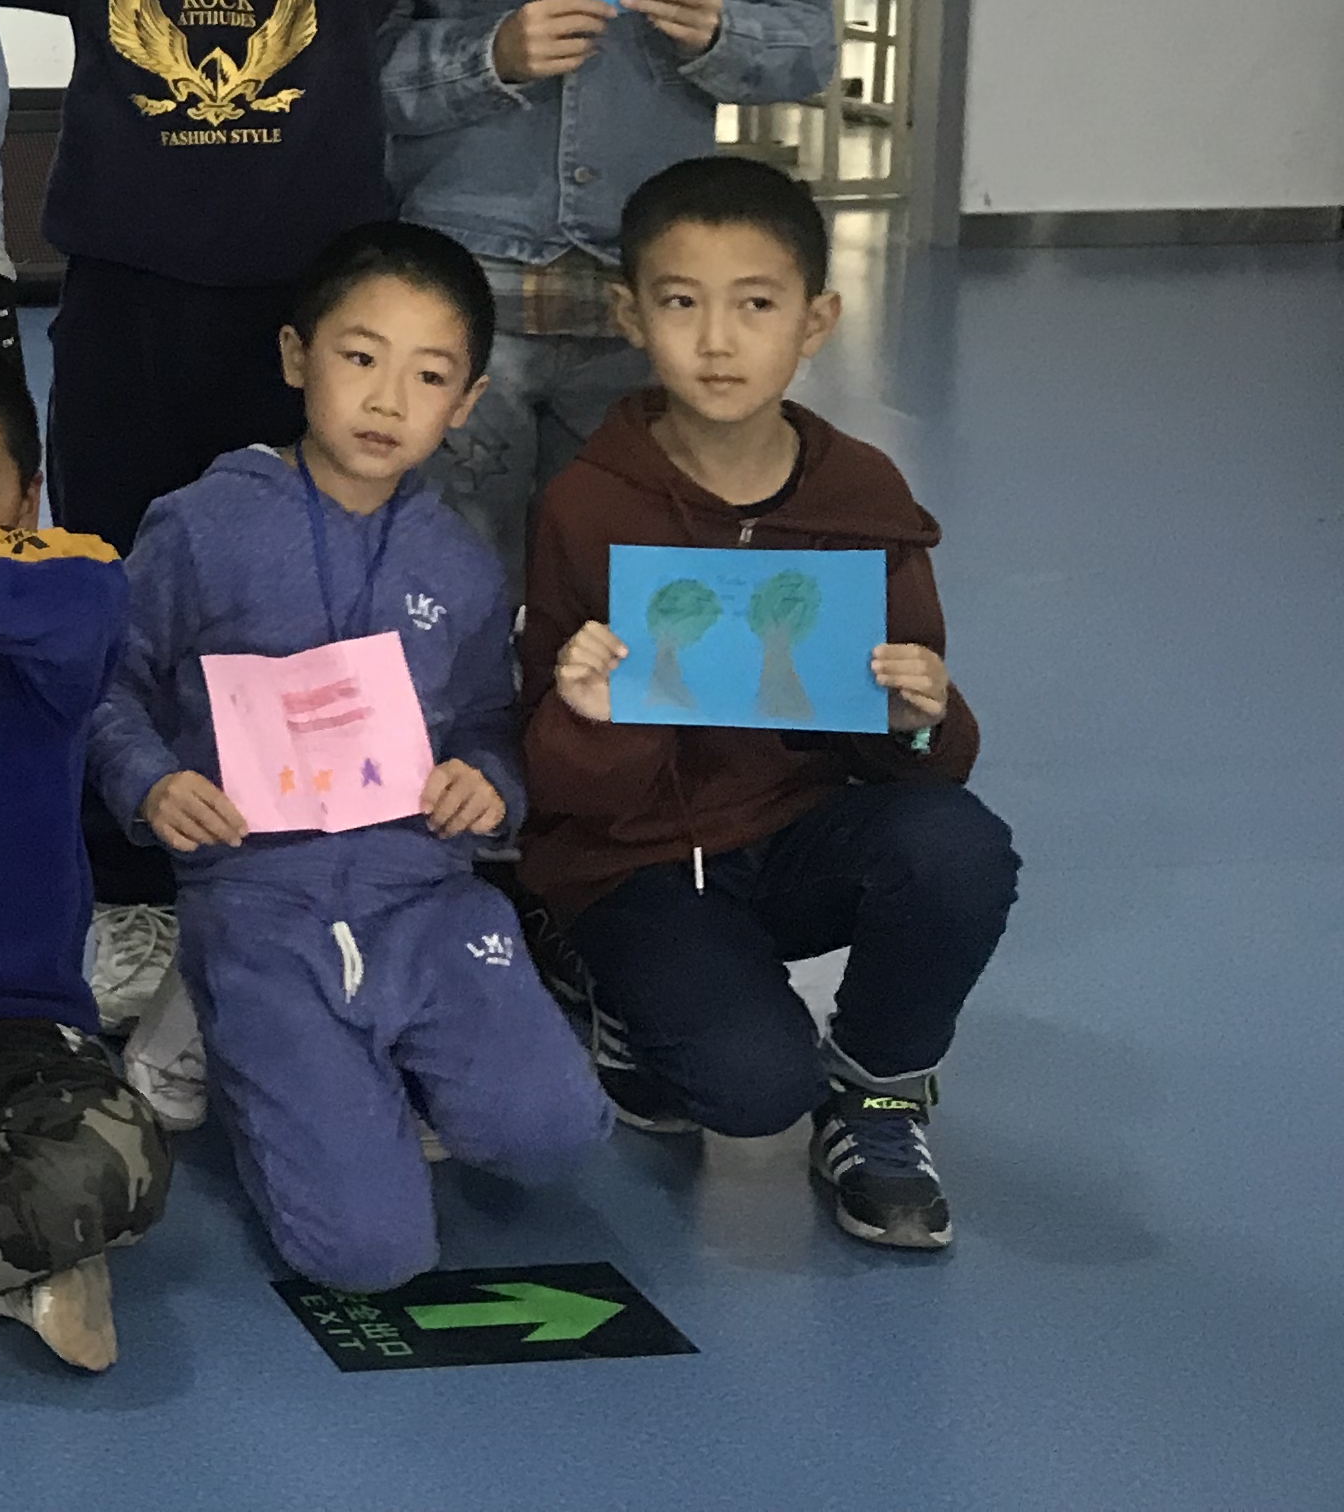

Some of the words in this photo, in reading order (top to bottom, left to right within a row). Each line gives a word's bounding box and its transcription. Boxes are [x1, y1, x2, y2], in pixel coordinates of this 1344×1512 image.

[161, 128, 227, 147] FASHION
[230, 128, 282, 145] STYLE
[299, 1294, 367, 1351] EXIT
